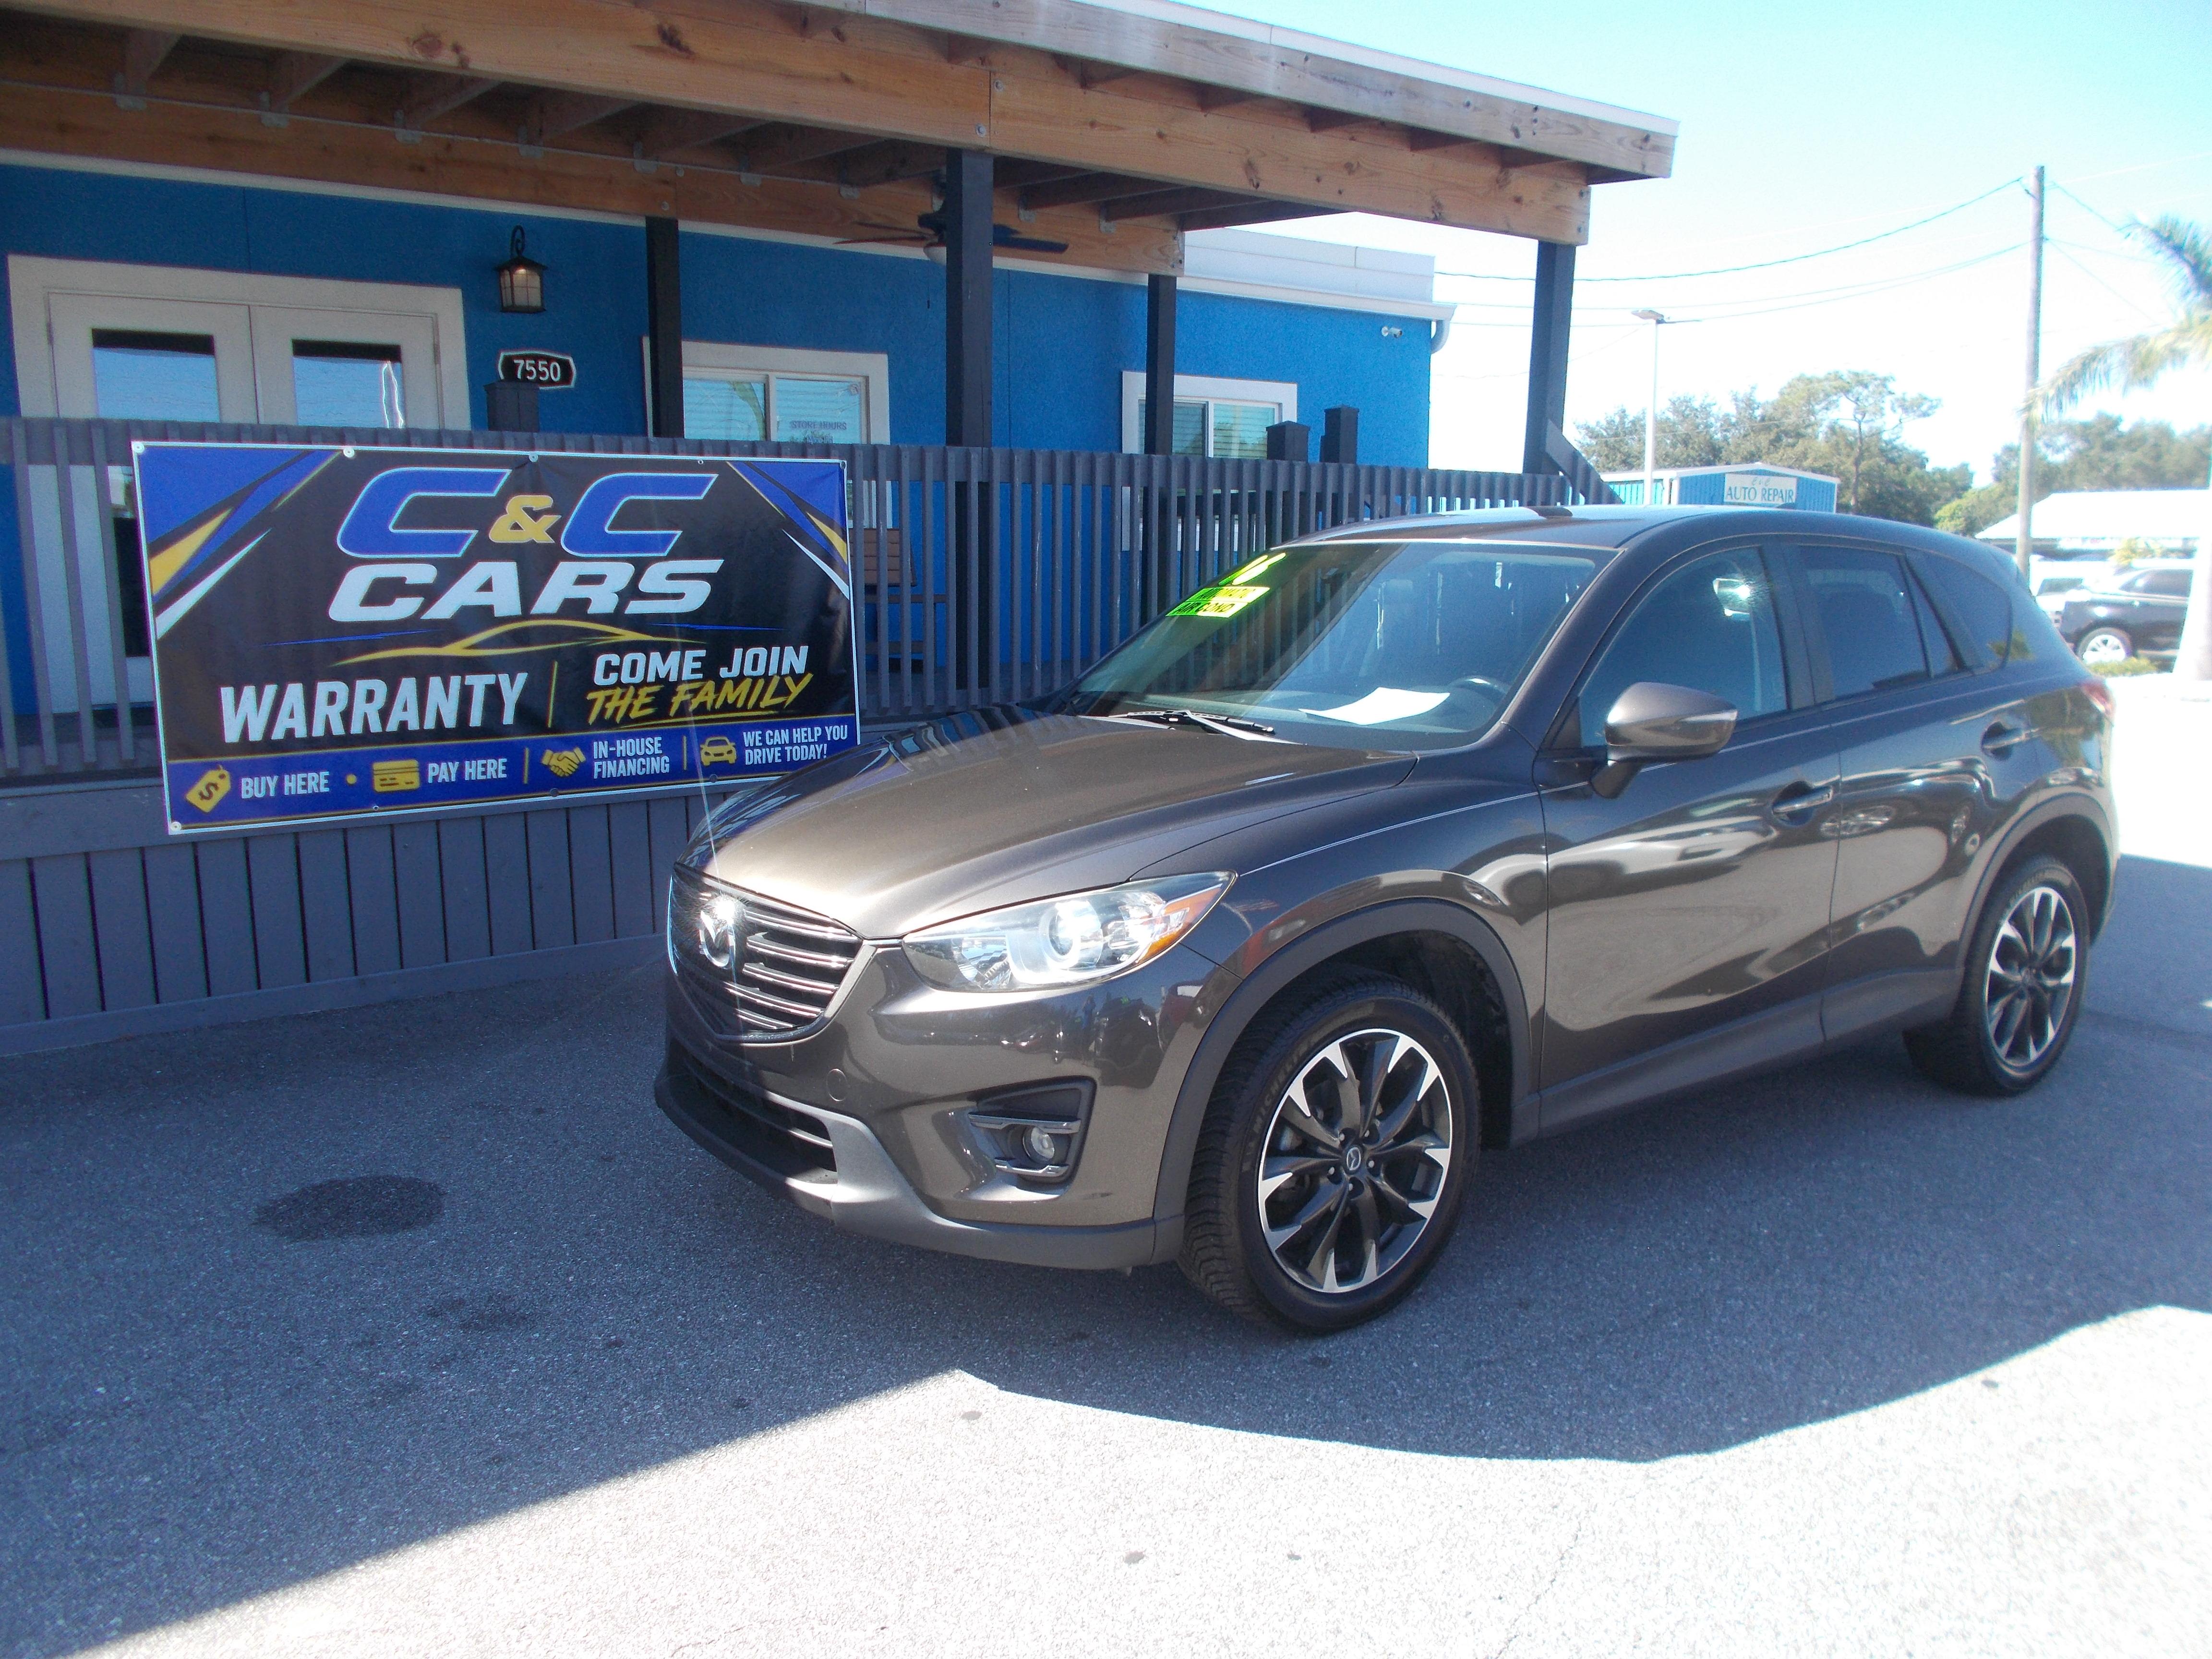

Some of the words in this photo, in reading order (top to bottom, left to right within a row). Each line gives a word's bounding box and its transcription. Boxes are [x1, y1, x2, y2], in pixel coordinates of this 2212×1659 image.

[513, 359, 561, 382] 7550
[792, 421, 816, 429] STORE
[820, 421, 847, 430] HOURS
[1726, 486, 1757, 501] AUTO
[1761, 487, 1794, 503] REPAIR
[328, 559, 724, 622] CARS
[594, 649, 707, 685] COME
[720, 646, 809, 678] JOIN
[220, 672, 529, 743] WARRANTY
[587, 684, 664, 725] THE
[669, 673, 814, 717] FAMILY
[593, 736, 662, 759] IN-HOUSE
[744, 731, 762, 747] WE
[766, 729, 789, 745] CAN
[793, 726, 822, 744] HELP
[824, 725, 848, 741] YOU
[745, 746, 782, 766] DRIVE
[784, 744, 828, 762] TODAY!
[428, 761, 459, 783] PAY
[465, 758, 507, 781] HERE
[593, 756, 670, 779] FINANCING
[241, 775, 278, 799] BUY
[284, 771, 330, 795] HERE
